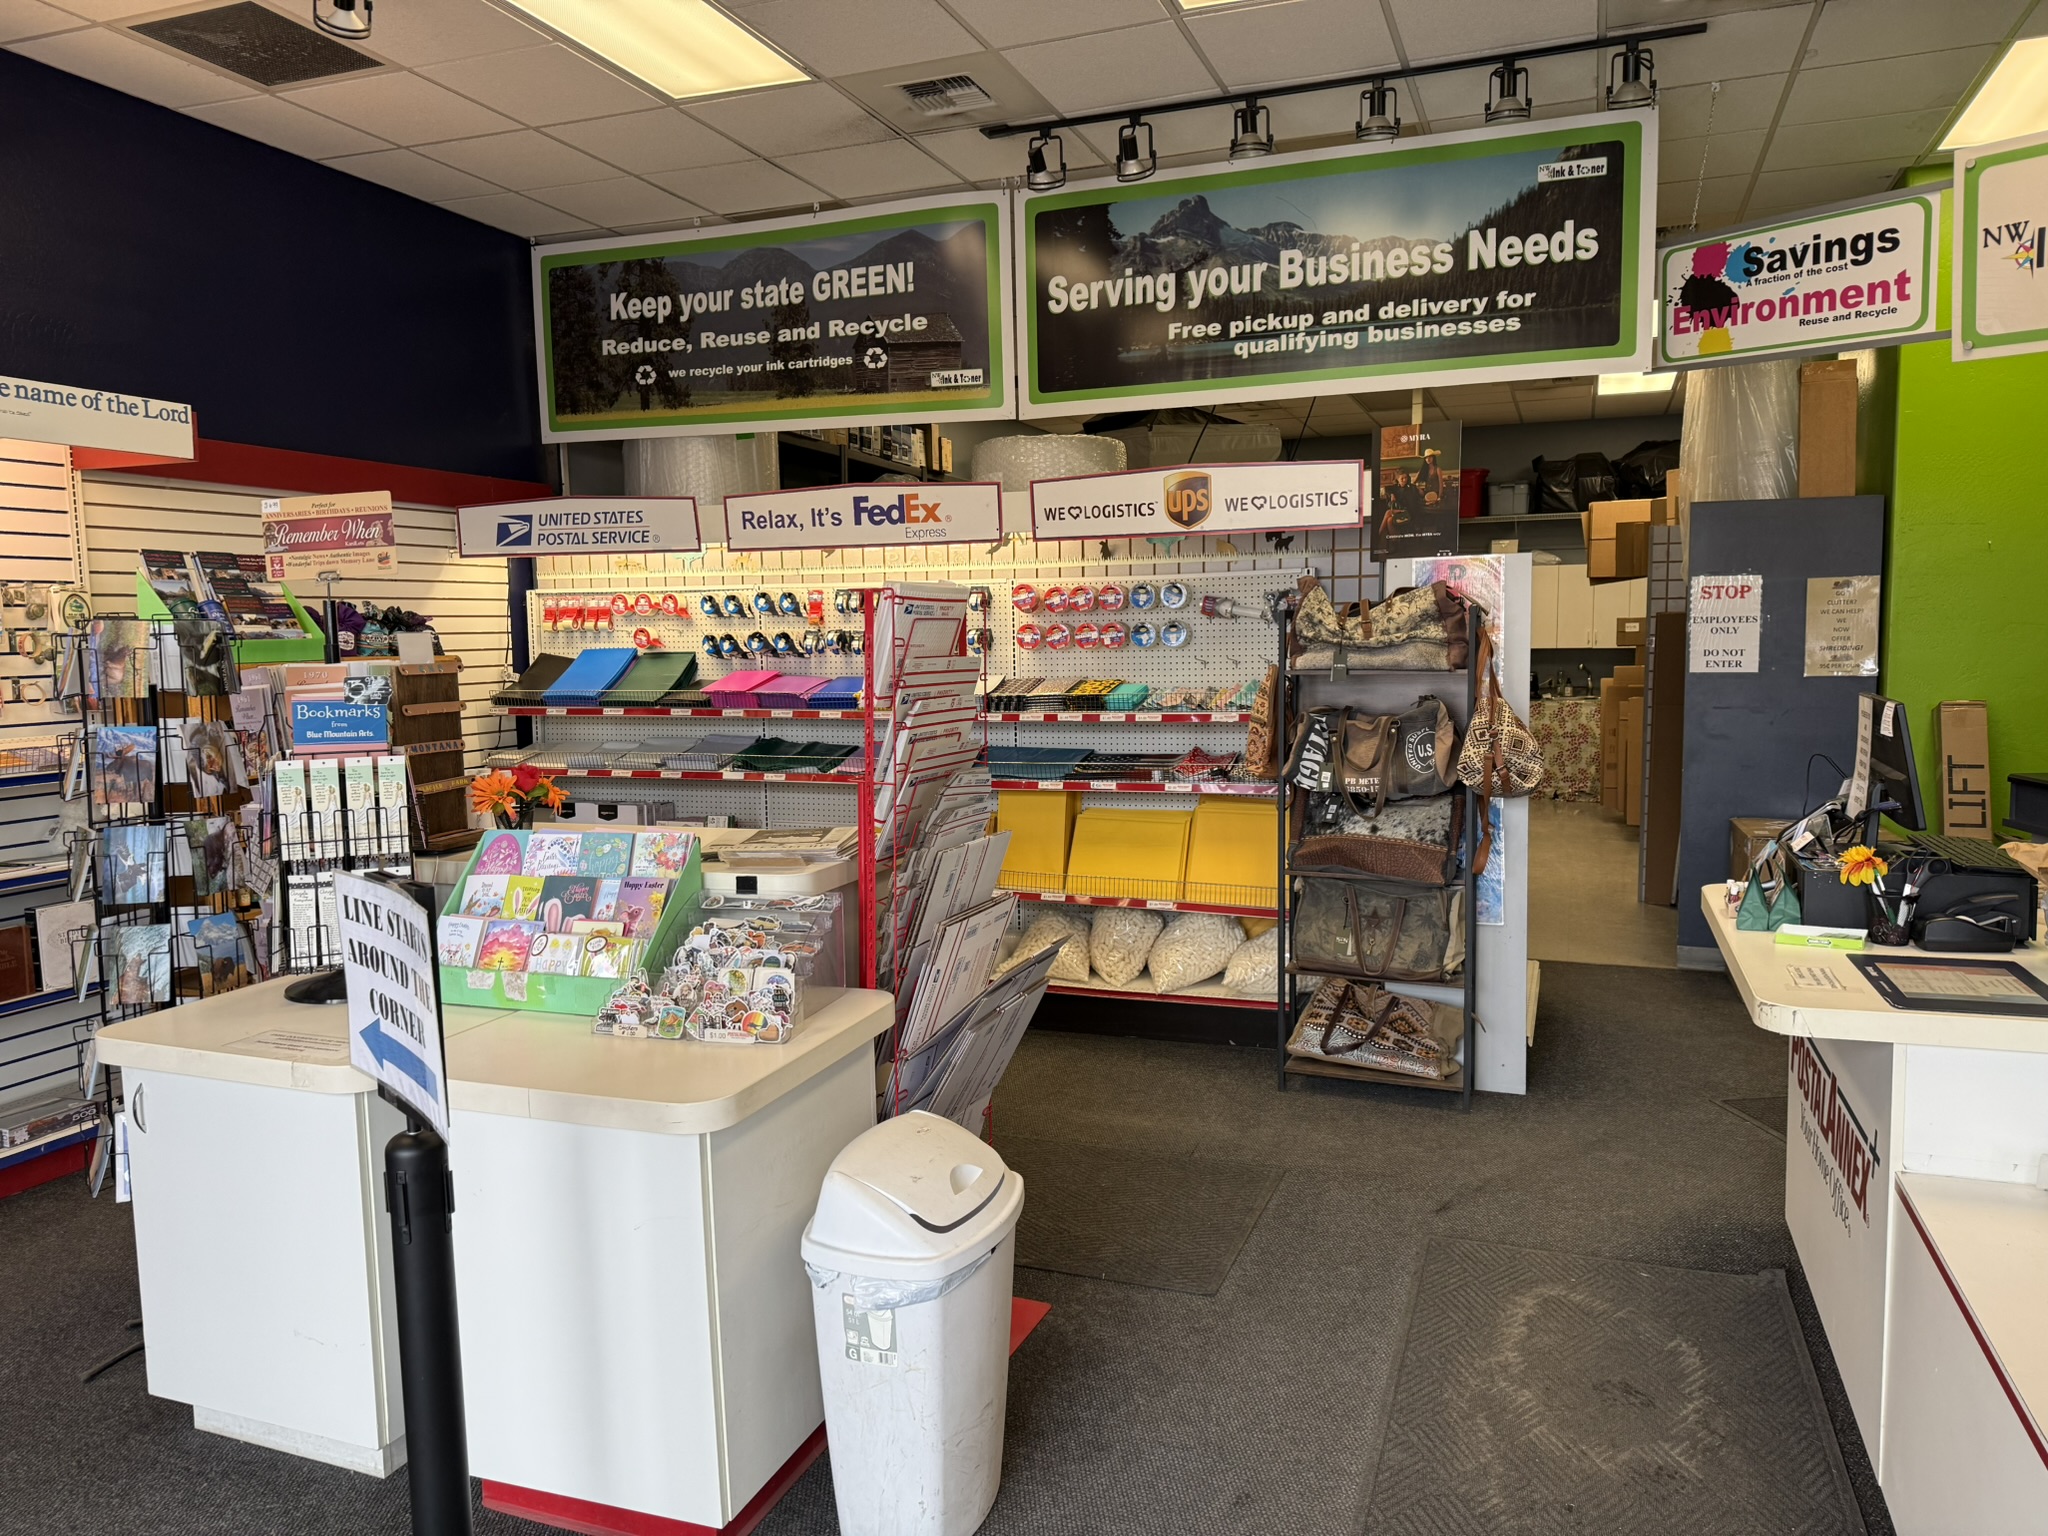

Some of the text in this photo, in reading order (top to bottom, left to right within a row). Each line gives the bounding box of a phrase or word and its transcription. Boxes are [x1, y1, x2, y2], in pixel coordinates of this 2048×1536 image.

[1567, 165, 1574, 176] &
[1982, 220, 2030, 248] NW
[1742, 227, 1901, 277] Savings
[1048, 219, 1600, 314] Serving your Business Needs
[1746, 262, 1849, 287] A fraction of the cost
[609, 262, 915, 323] Keep your state GREEN!
[1673, 269, 1912, 335] Environment
[1168, 289, 1537, 340] Free pickup and delivery for
[1799, 305, 1898, 327] Reuse and Recycle
[601, 313, 928, 356] Reduce, Reuse and Recycle
[1234, 315, 1522, 359] qualifying businesses
[668, 354, 853, 379] we recycle your ink cartridges
[953, 374, 959, 383] &
[14, 384, 78, 407] name
[81, 392, 103, 412] of
[106, 395, 140, 417] the
[141, 399, 190, 425] Lord
[1409, 433, 1431, 442] MYRA
[1043, 501, 1156, 521] WE LOGISTICS
[1167, 487, 1209, 524] ups
[1225, 490, 1348, 512] WE LOGISTICS
[264, 510, 312, 520] ANNIVERSARIES
[315, 507, 351, 515] BIRTHDAYS
[538, 510, 644, 526] UNITED STATES
[742, 493, 942, 531] Relax, It's FedEx
[271, 518, 381, 546] Remember When
[537, 529, 650, 546] POSTAL SERVICE
[905, 526, 947, 541] Express
[1700, 585, 1753, 600] STOP
[1692, 615, 1759, 625] EMPLOYEES
[1710, 626, 1740, 635] ONLY
[1703, 648, 1745, 657] DO NOT
[1705, 660, 1743, 669] ENTER
[303, 671, 328, 679] 1970
[297, 704, 381, 719] Bookmarks
[323, 730, 357, 738] Mountain
[411, 741, 459, 753] MONTANA
[1344, 777, 1381, 785] PB METE
[1949, 754, 1988, 828] LIFT
[624, 881, 665, 890] Happy Easter
[343, 894, 384, 932] LINE
[386, 907, 428, 964] STARTS
[347, 937, 433, 1014] AROUND THE
[369, 987, 427, 1049] CORNER
[709, 1032, 727, 1040] $1.00
[72, 1108, 97, 1121] 500
[1812, 1127, 1829, 1186] Home
[848, 1348, 858, 1359] G
